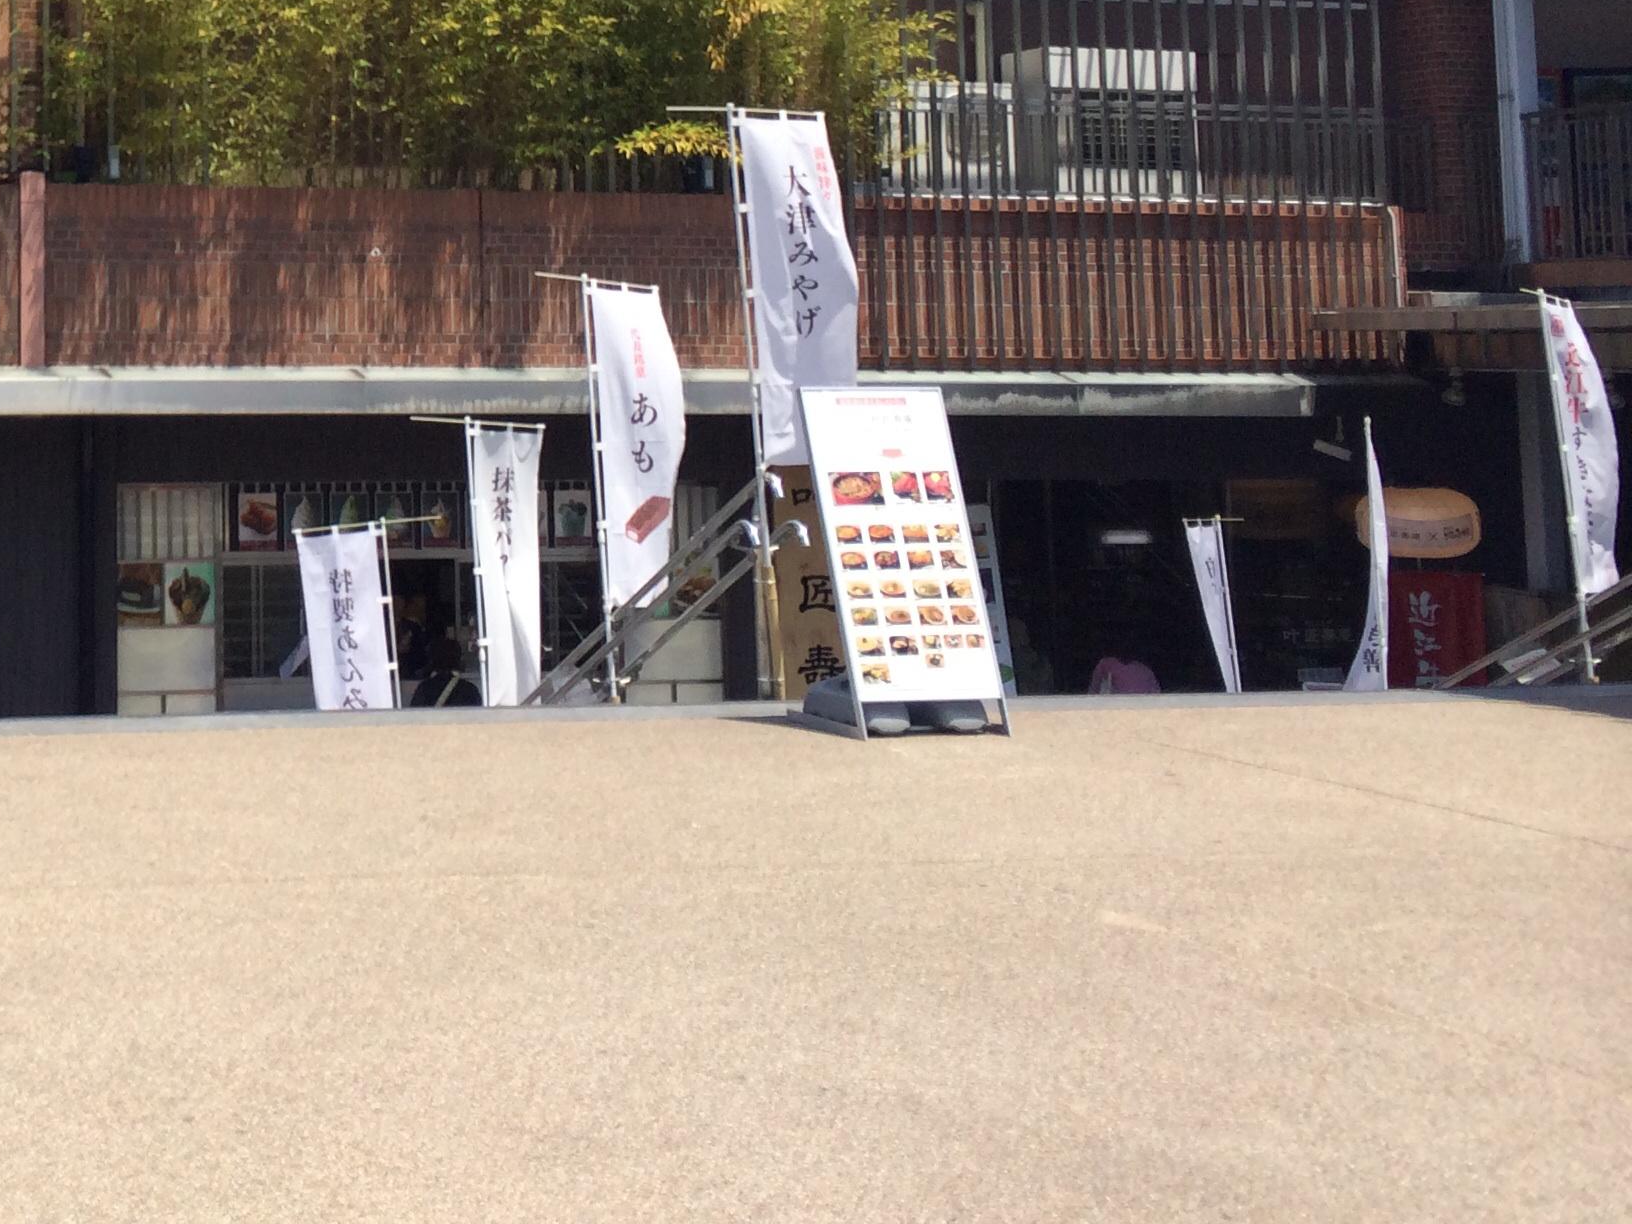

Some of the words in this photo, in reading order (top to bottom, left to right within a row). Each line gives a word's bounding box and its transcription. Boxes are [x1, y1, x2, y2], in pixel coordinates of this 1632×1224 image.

[784, 165, 821, 338] 大津みやげ
[630, 392, 658, 474] あも
